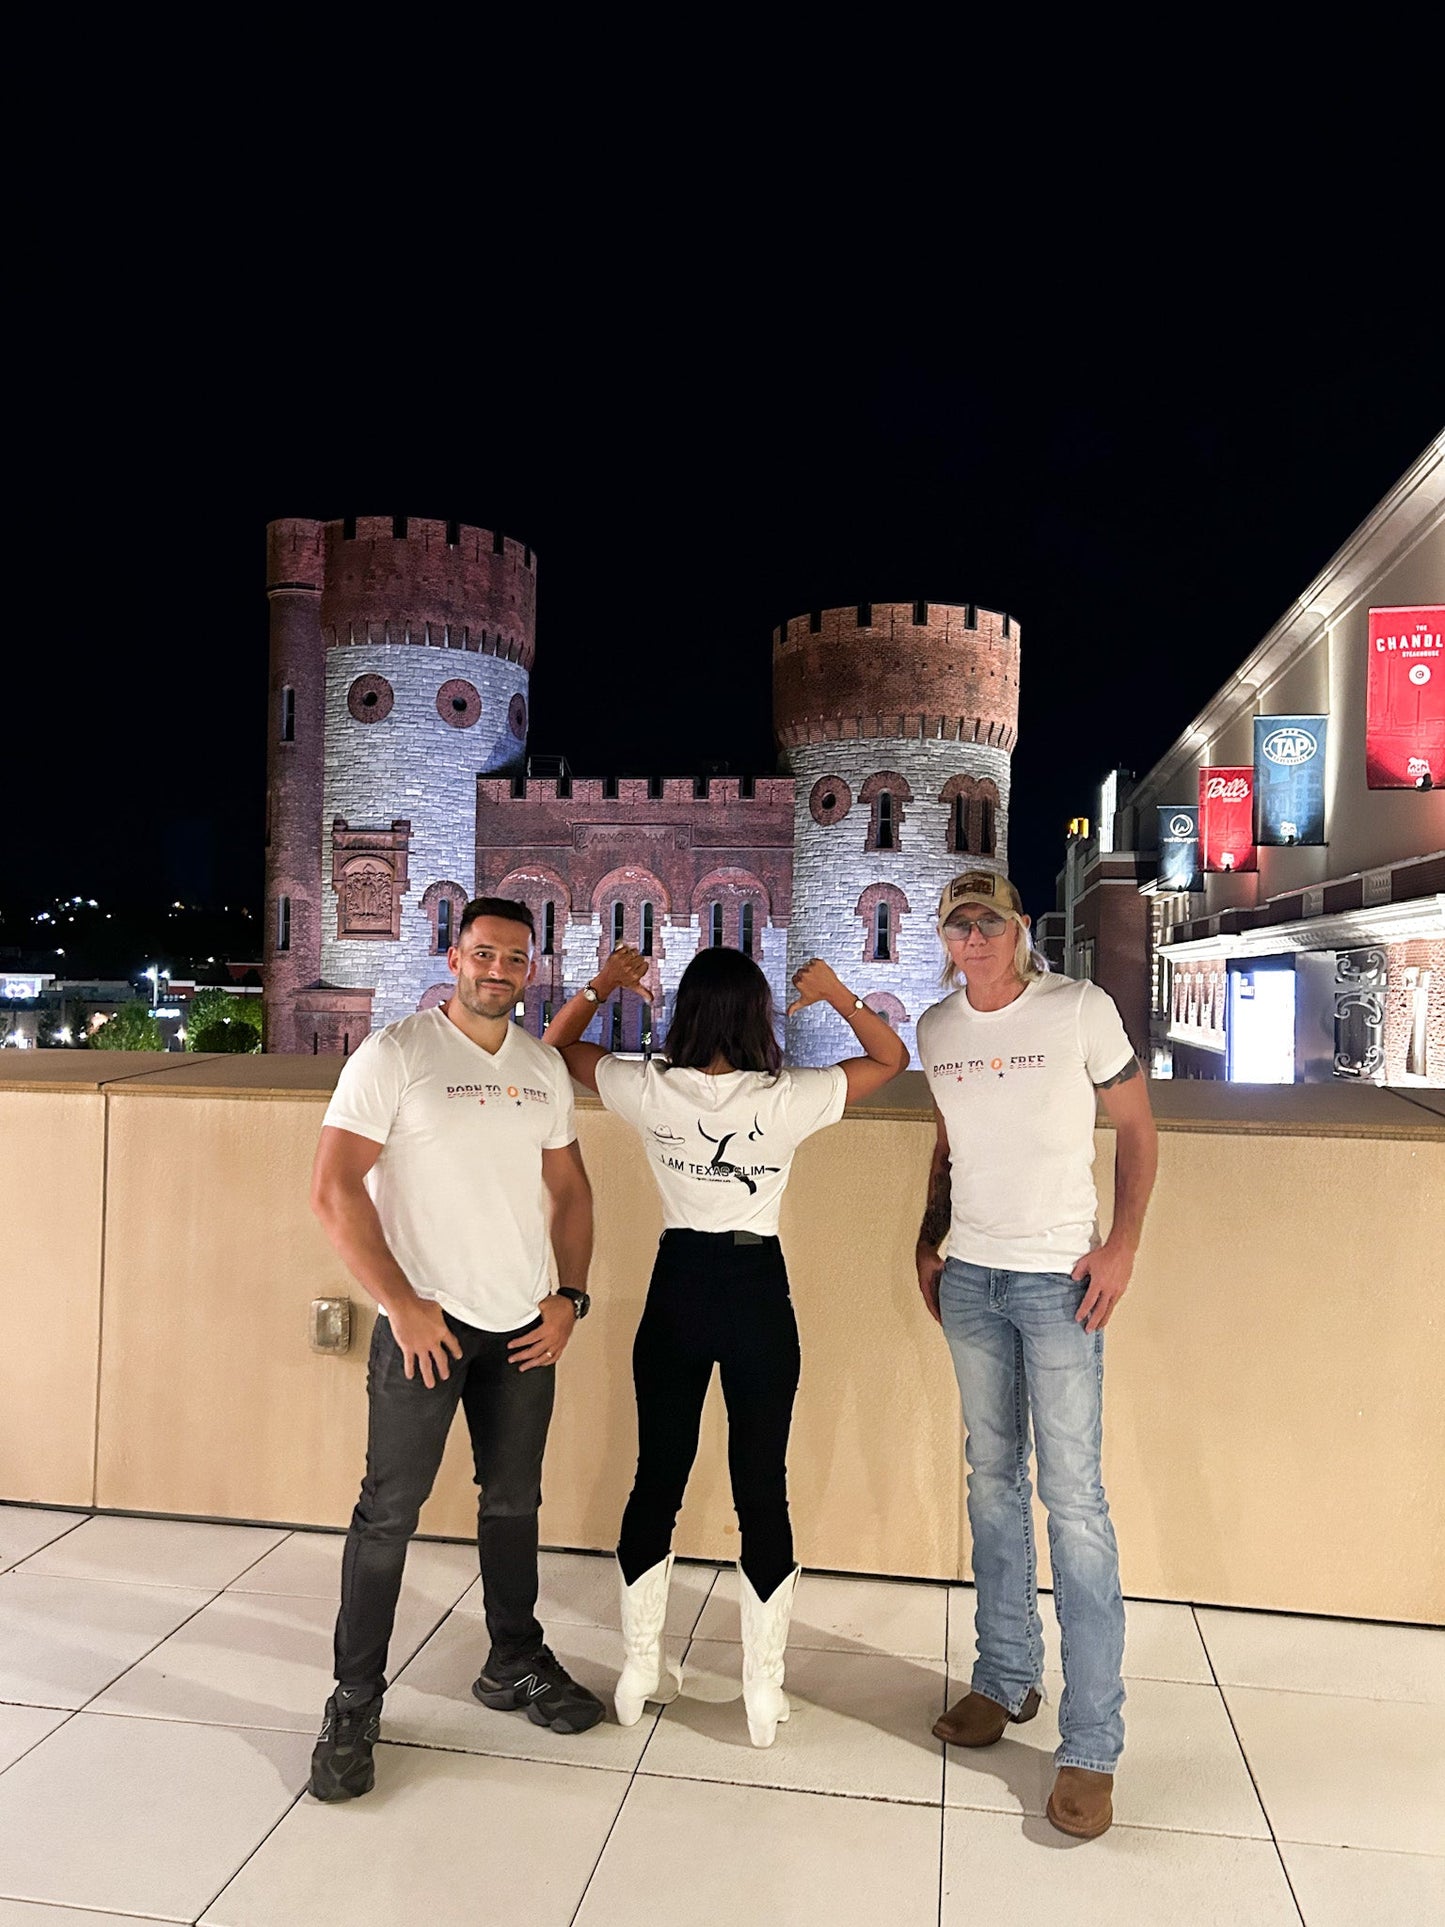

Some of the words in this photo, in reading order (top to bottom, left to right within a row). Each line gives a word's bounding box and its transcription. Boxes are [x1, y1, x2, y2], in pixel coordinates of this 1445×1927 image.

[1376, 634, 1443, 652] CHANDL
[1273, 737, 1309, 757] TAP
[1207, 777, 1250, 798] Bill's
[668, 1157, 684, 1171] AM
[689, 1163, 730, 1177] TEXAS
[733, 1165, 765, 1176] SLIM
